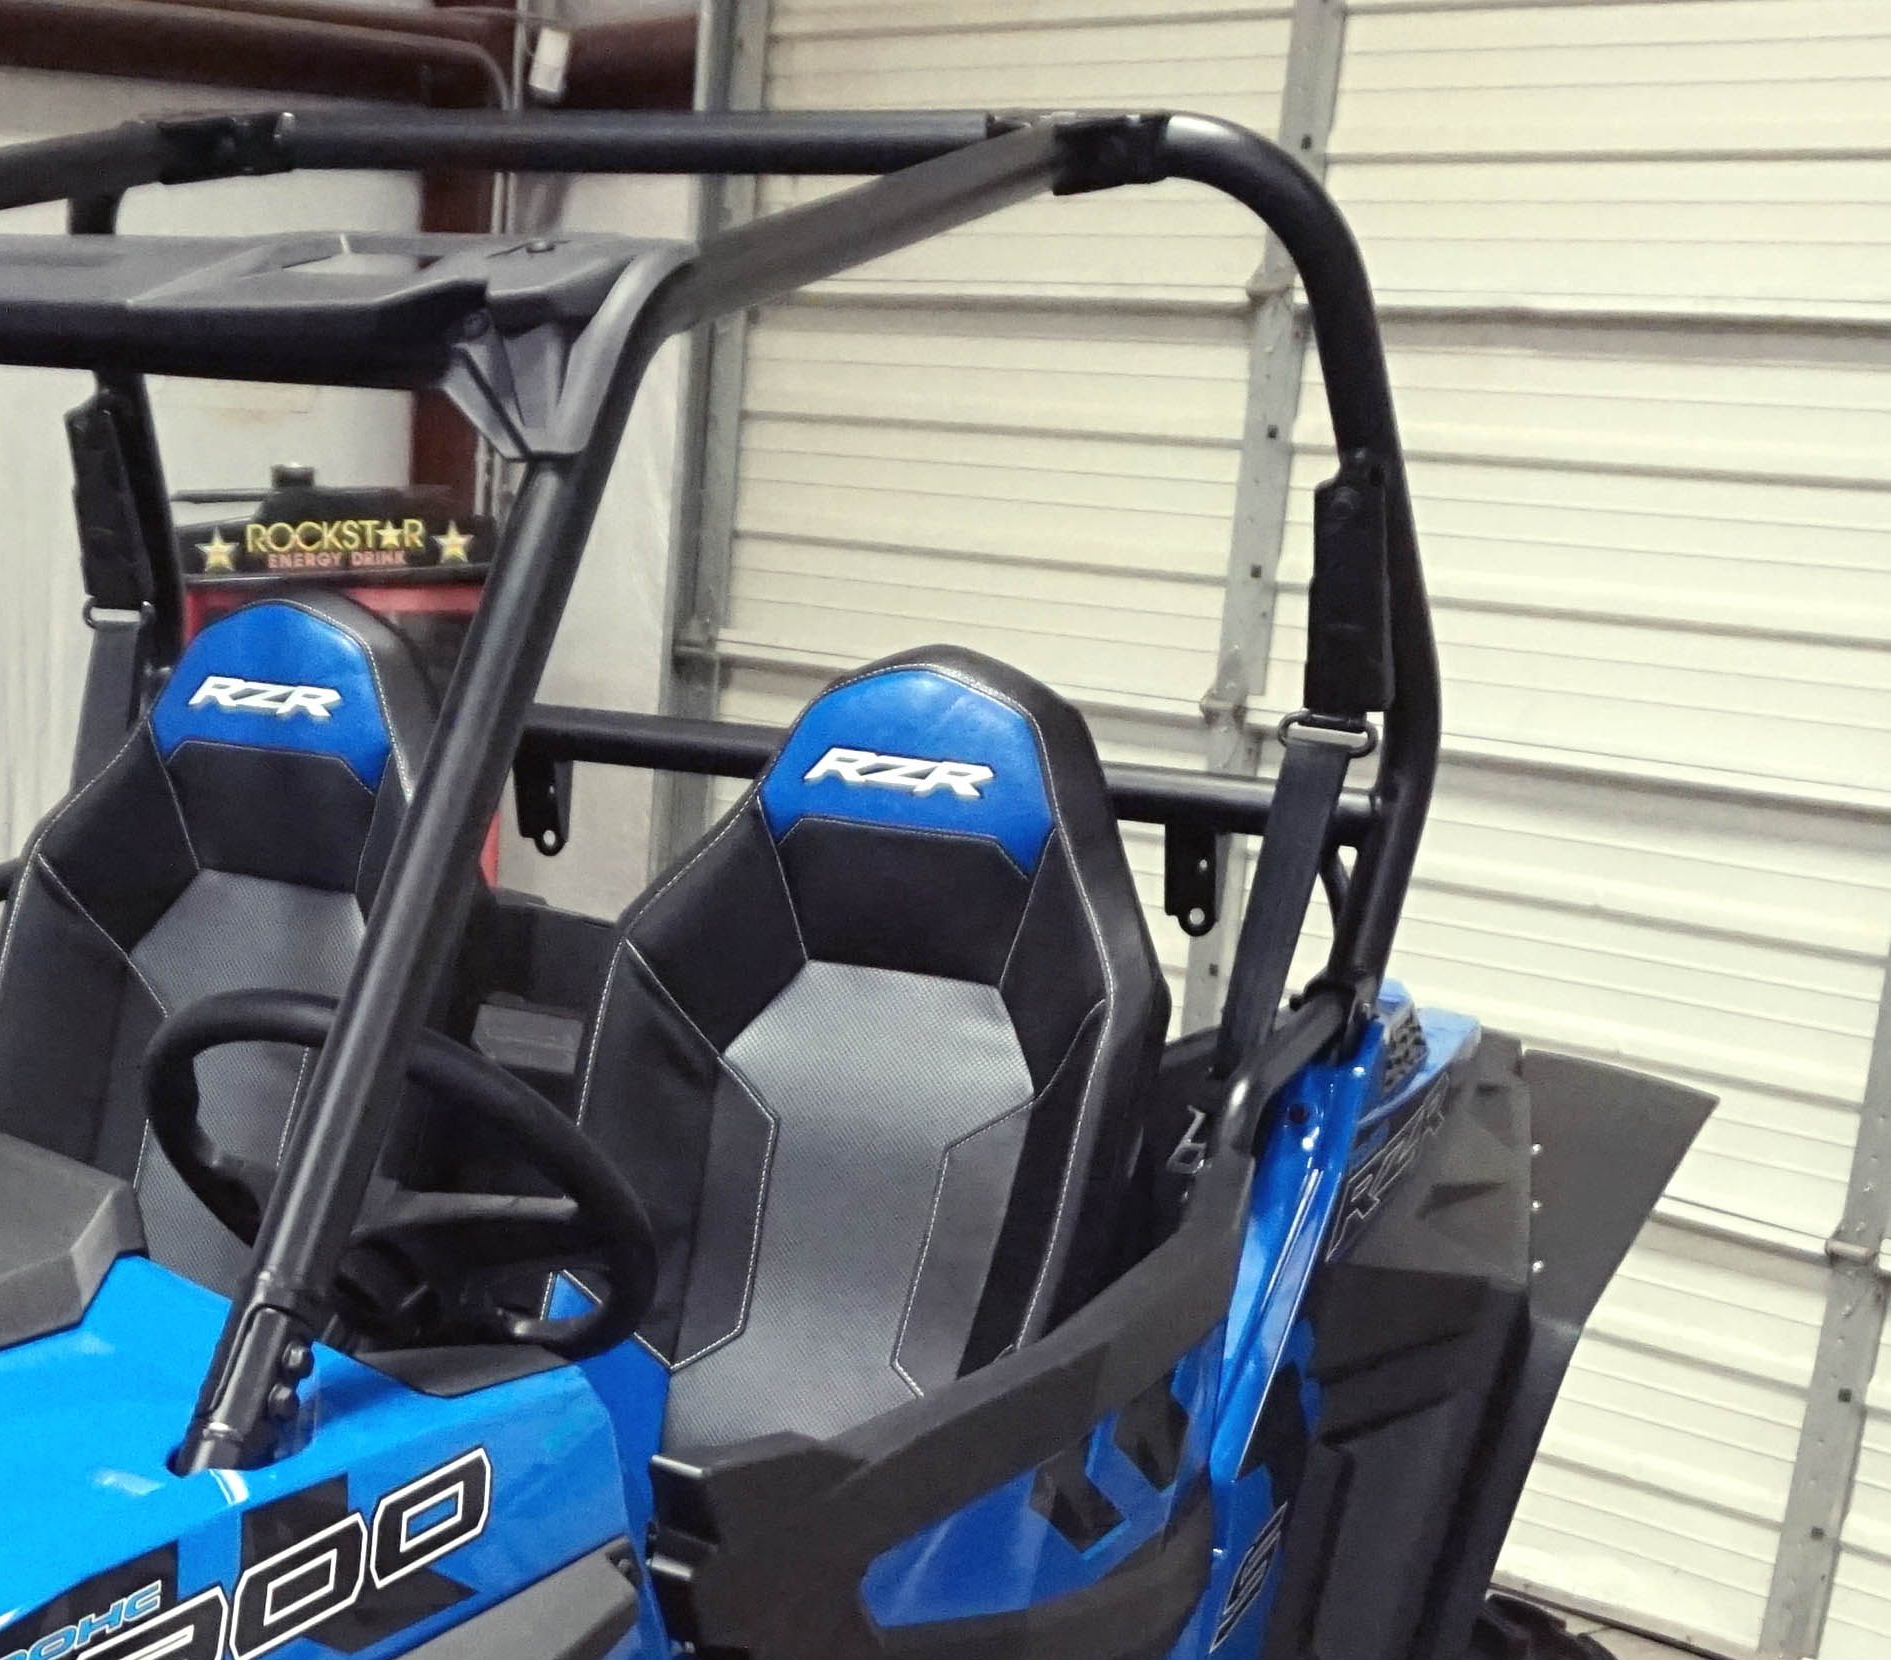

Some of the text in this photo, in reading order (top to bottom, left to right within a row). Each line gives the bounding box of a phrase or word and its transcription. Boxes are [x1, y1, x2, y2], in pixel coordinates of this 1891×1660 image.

[268, 550, 407, 569] ENERGY DRINK
[188, 675, 342, 719] RZR
[804, 748, 994, 799] RZR
